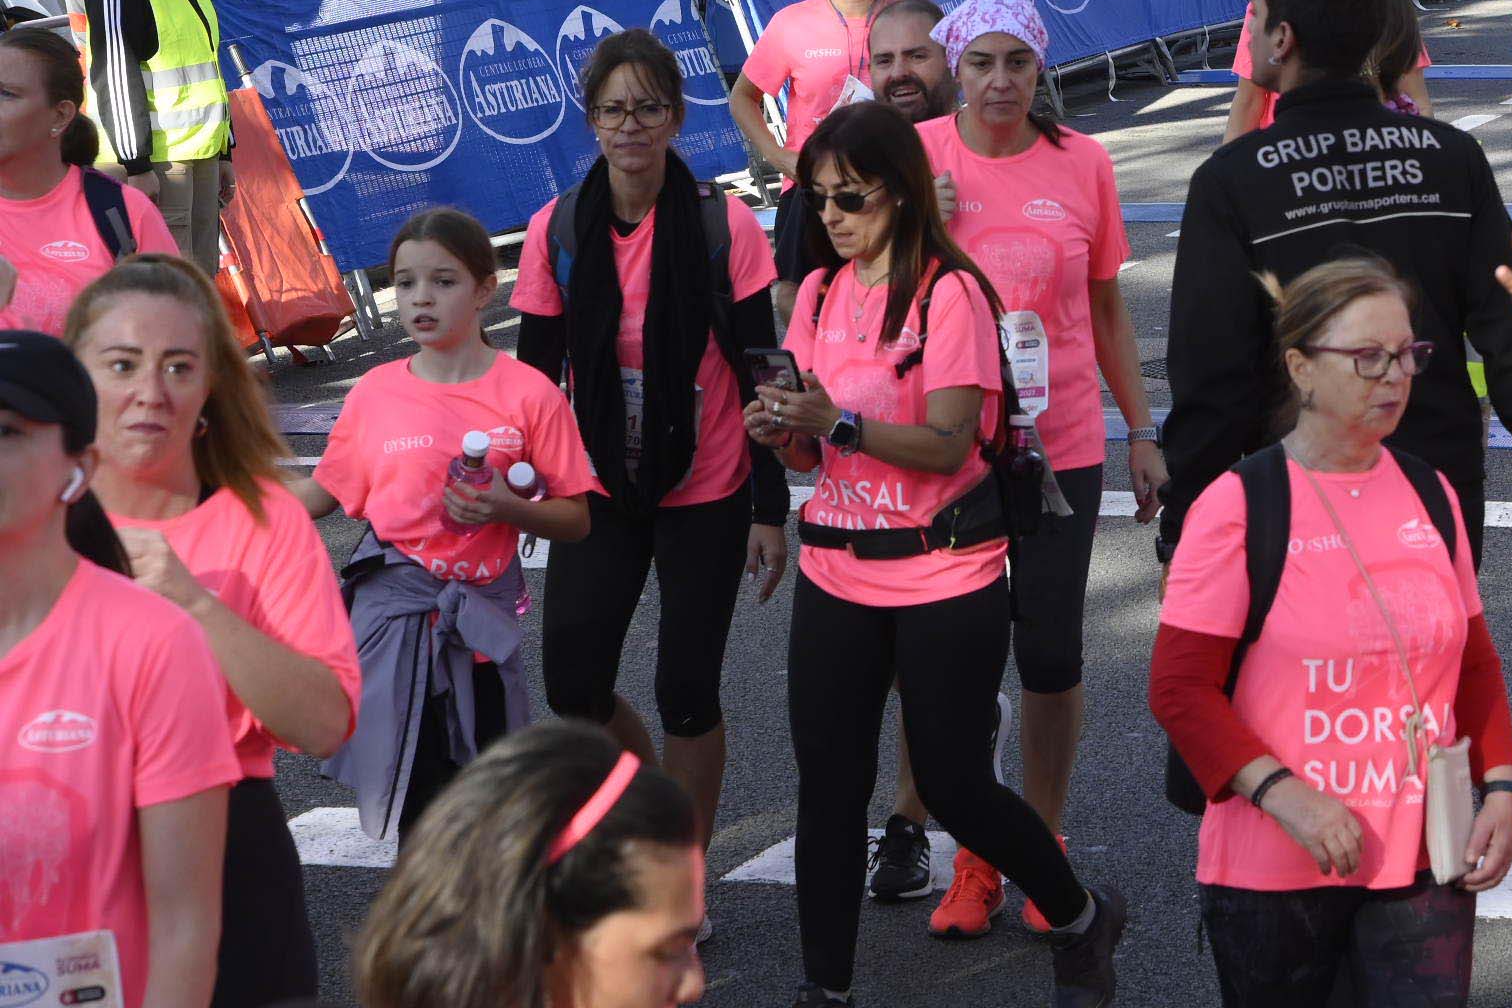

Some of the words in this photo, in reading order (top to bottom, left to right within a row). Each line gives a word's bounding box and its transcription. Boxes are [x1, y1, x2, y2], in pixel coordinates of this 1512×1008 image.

[469, 70, 562, 119] ASTURIANA
[1256, 131, 1337, 169] GRUP
[1344, 125, 1442, 154] BARNA
[1291, 158, 1424, 197] PORTERS
[383, 434, 433, 454] OYSHO
[1303, 658, 1355, 693] TU
[1303, 758, 1425, 805] SUMA
